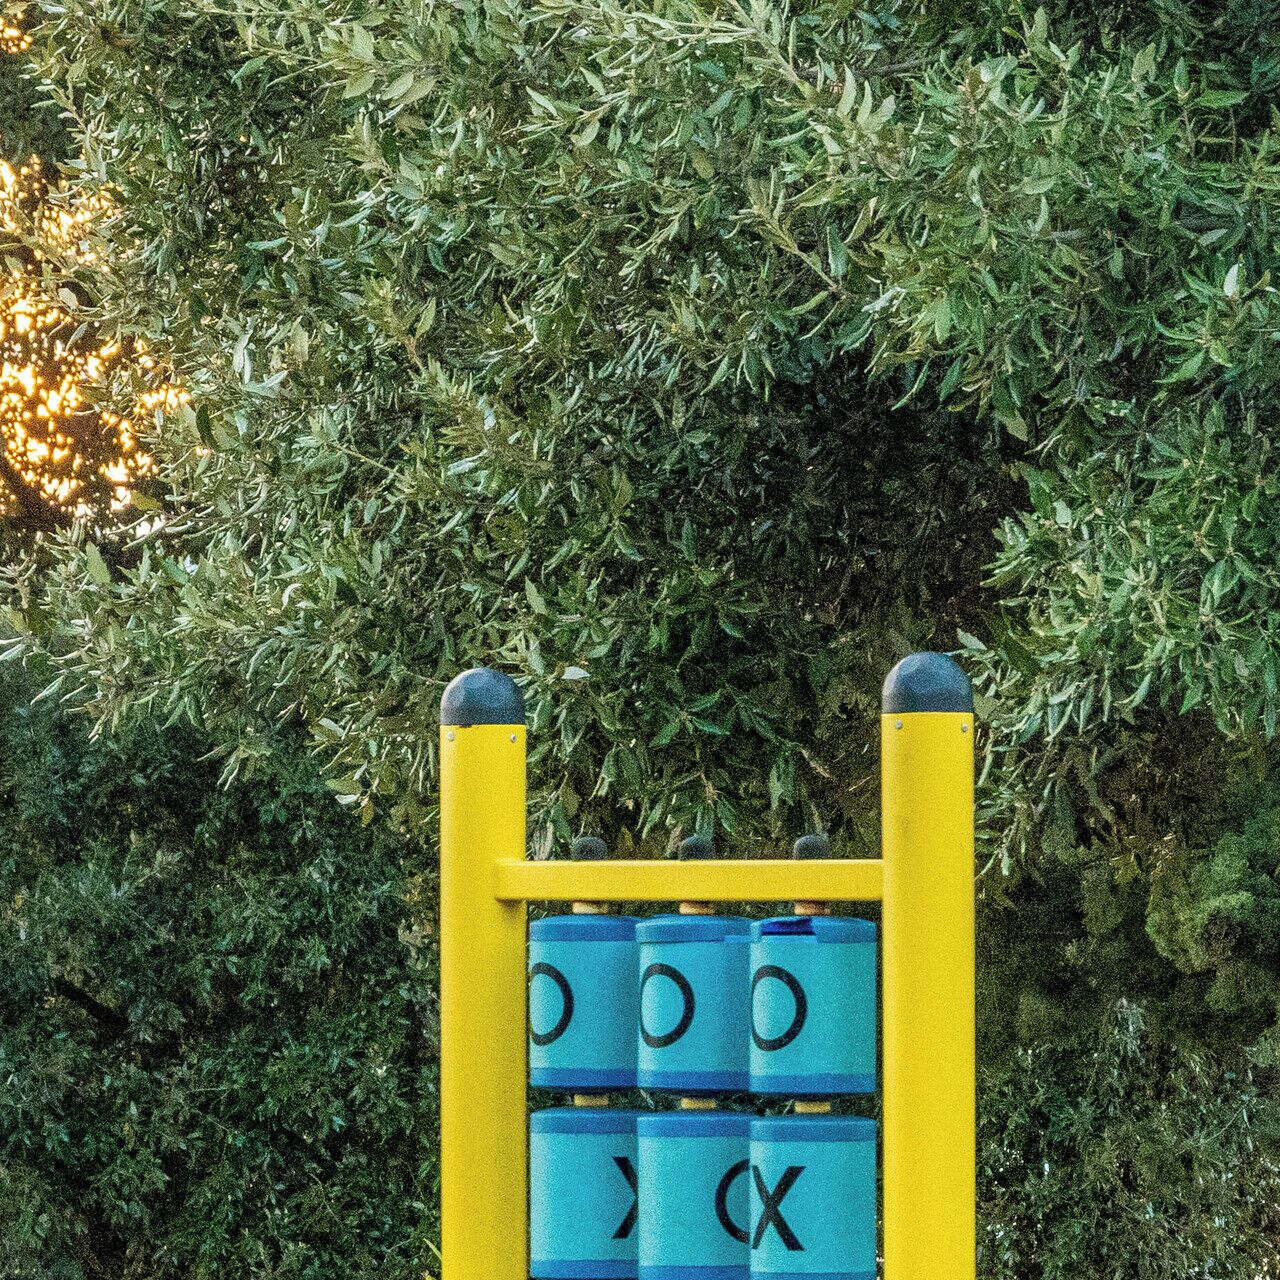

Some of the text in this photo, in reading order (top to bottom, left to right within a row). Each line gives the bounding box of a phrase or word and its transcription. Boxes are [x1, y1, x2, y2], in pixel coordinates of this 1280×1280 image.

[530, 962, 807, 1051] O O O
[752, 1165, 805, 1251] X
